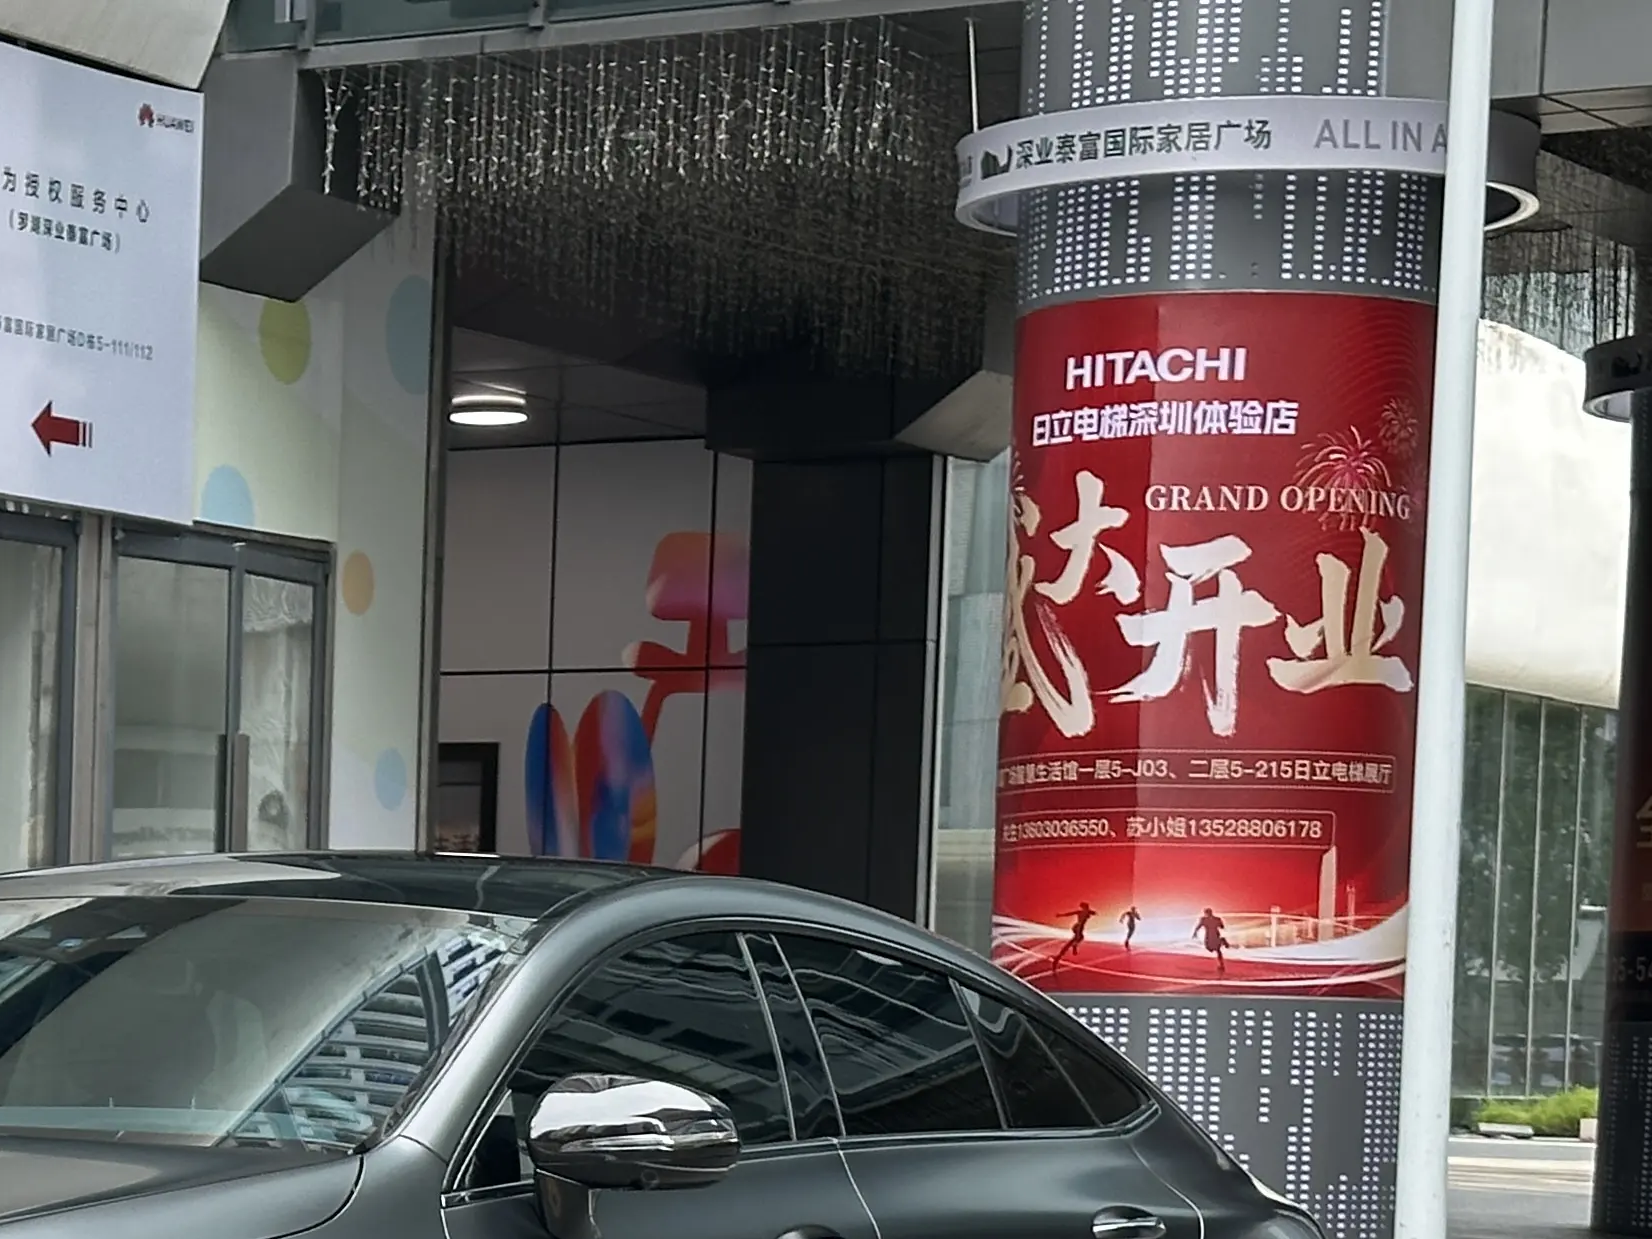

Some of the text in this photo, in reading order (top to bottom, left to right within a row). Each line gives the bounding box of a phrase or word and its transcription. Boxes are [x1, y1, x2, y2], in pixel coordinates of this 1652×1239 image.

[1314, 119, 1381, 150] ALL
[1391, 120, 1422, 152] IN
[1065, 347, 1248, 390] HITACHI
[1032, 400, 1299, 447] 日立电梯深圳体验店
[1145, 484, 1411, 520] GRAND OPENING
